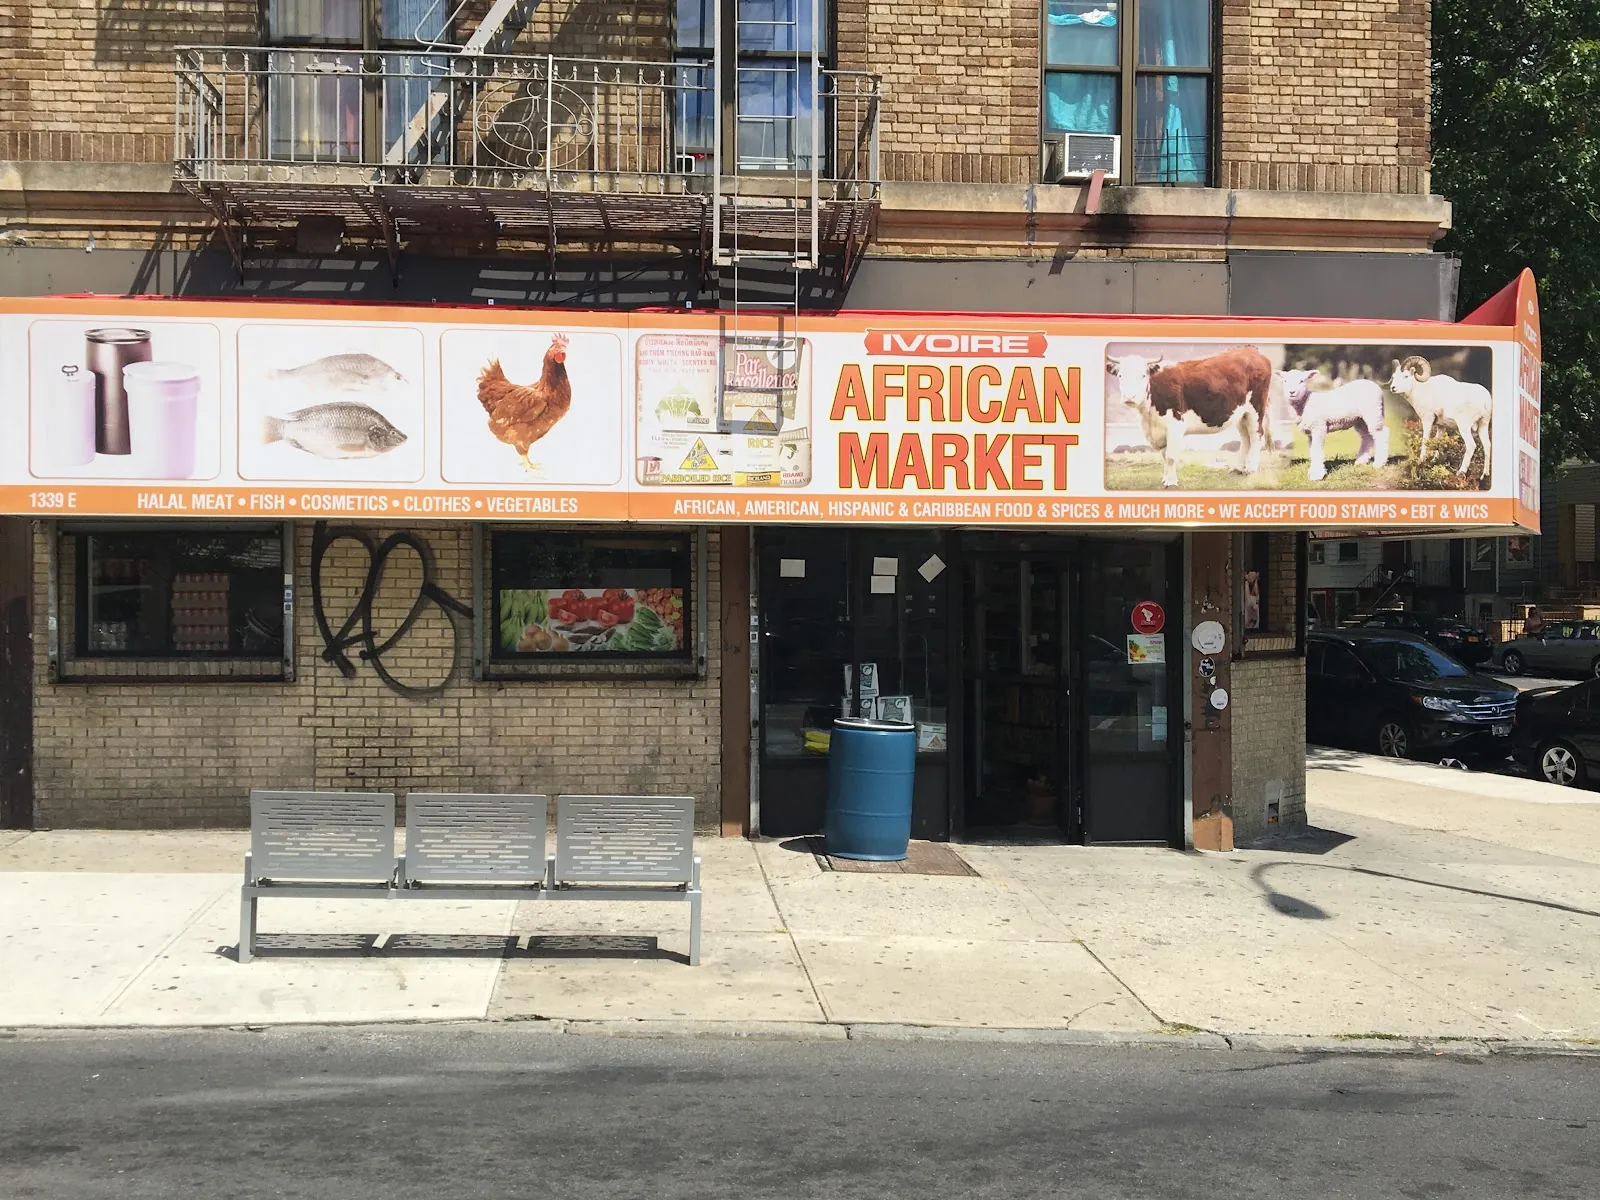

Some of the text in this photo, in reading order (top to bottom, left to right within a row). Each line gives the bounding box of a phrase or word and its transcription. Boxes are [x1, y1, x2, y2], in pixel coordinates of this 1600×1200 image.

[882, 333, 1030, 354] IVOIRE
[736, 352, 760, 375] Par
[725, 369, 796, 389] Excellence
[829, 364, 1081, 424] AFRICAN
[747, 438, 774, 449] RICE
[838, 432, 1079, 490] MARKET
[661, 474, 711, 482] PARBOILED
[712, 474, 732, 482] RICE
[30, 493, 77, 508] 1339 E
[137, 493, 579, 513] HALAL MEAT FISH COSMETICS CLOTHES VEGETABLES
[673, 500, 1489, 519] AFRICAN, AMERICAN, HISPANIC & CARIBBEAN FOOD & SPICES & MUCH MORE WE ACCEPT FOOD STAMPS EBT & WICS
